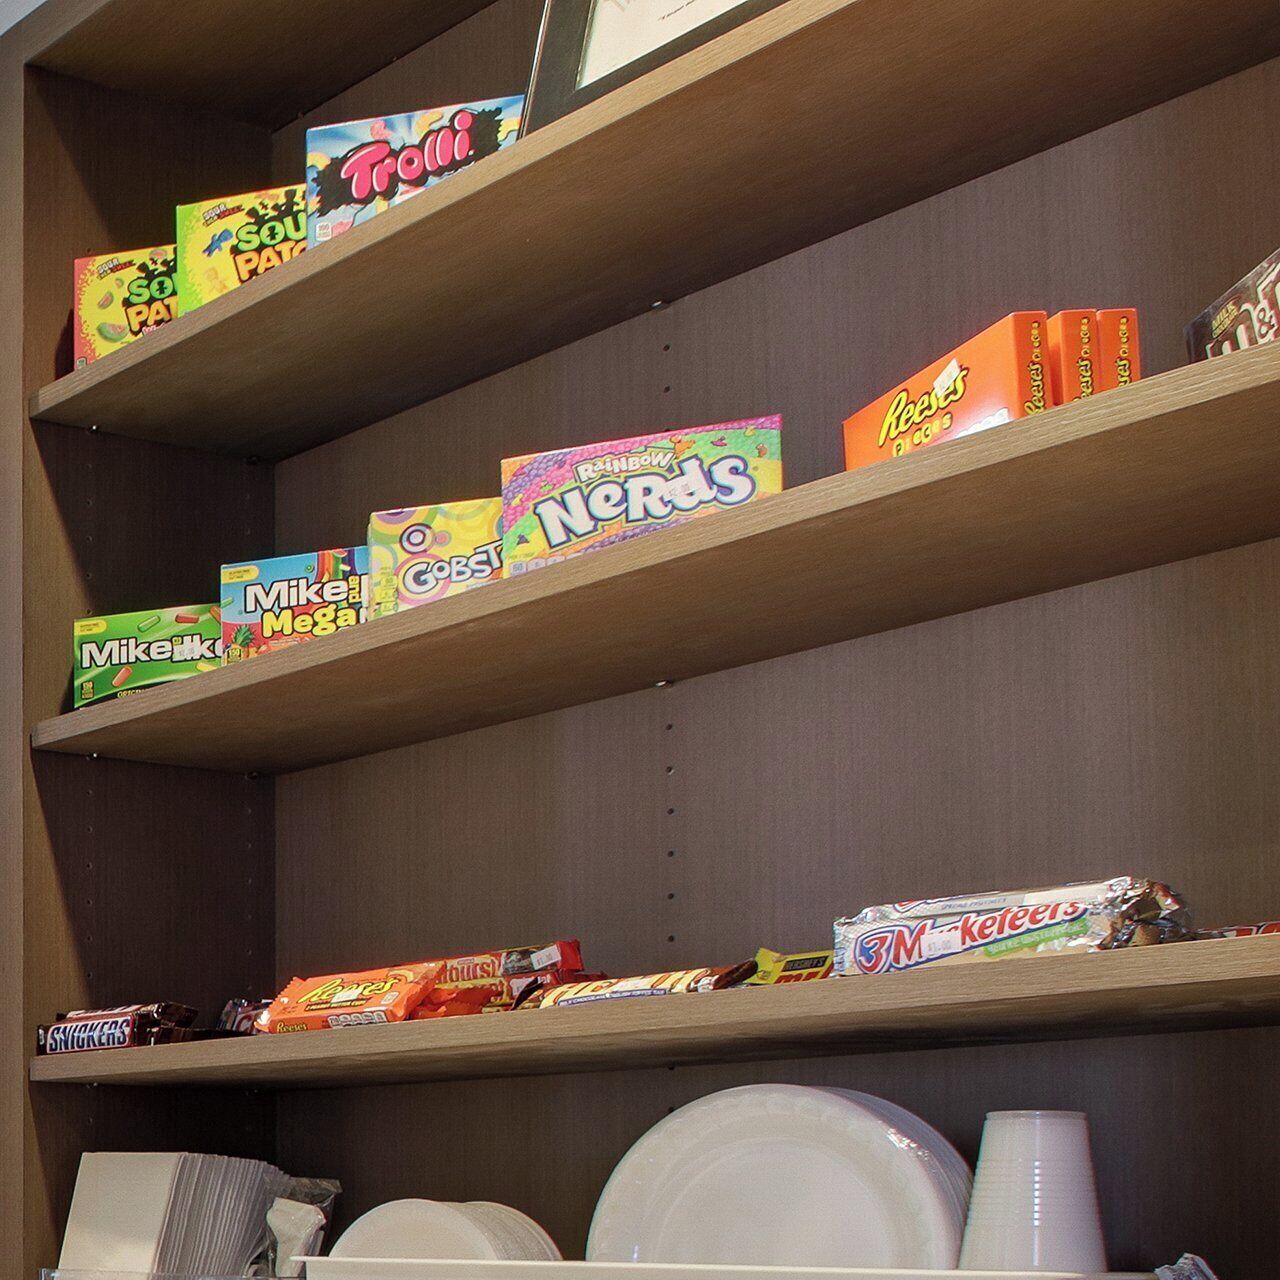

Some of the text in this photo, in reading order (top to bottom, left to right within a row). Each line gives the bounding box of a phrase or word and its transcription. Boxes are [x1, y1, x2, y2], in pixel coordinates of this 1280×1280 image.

[341, 110, 473, 199] Trolli
[127, 276, 177, 304] SO
[878, 363, 970, 449] Reeses
[245, 578, 349, 613] Mike
[262, 604, 358, 637] Mega
[80, 636, 174, 669] Mike
[857, 932, 894, 972] 3
[891, 899, 1089, 966] Mketeers
[48, 1017, 132, 1052] SNICKERS
